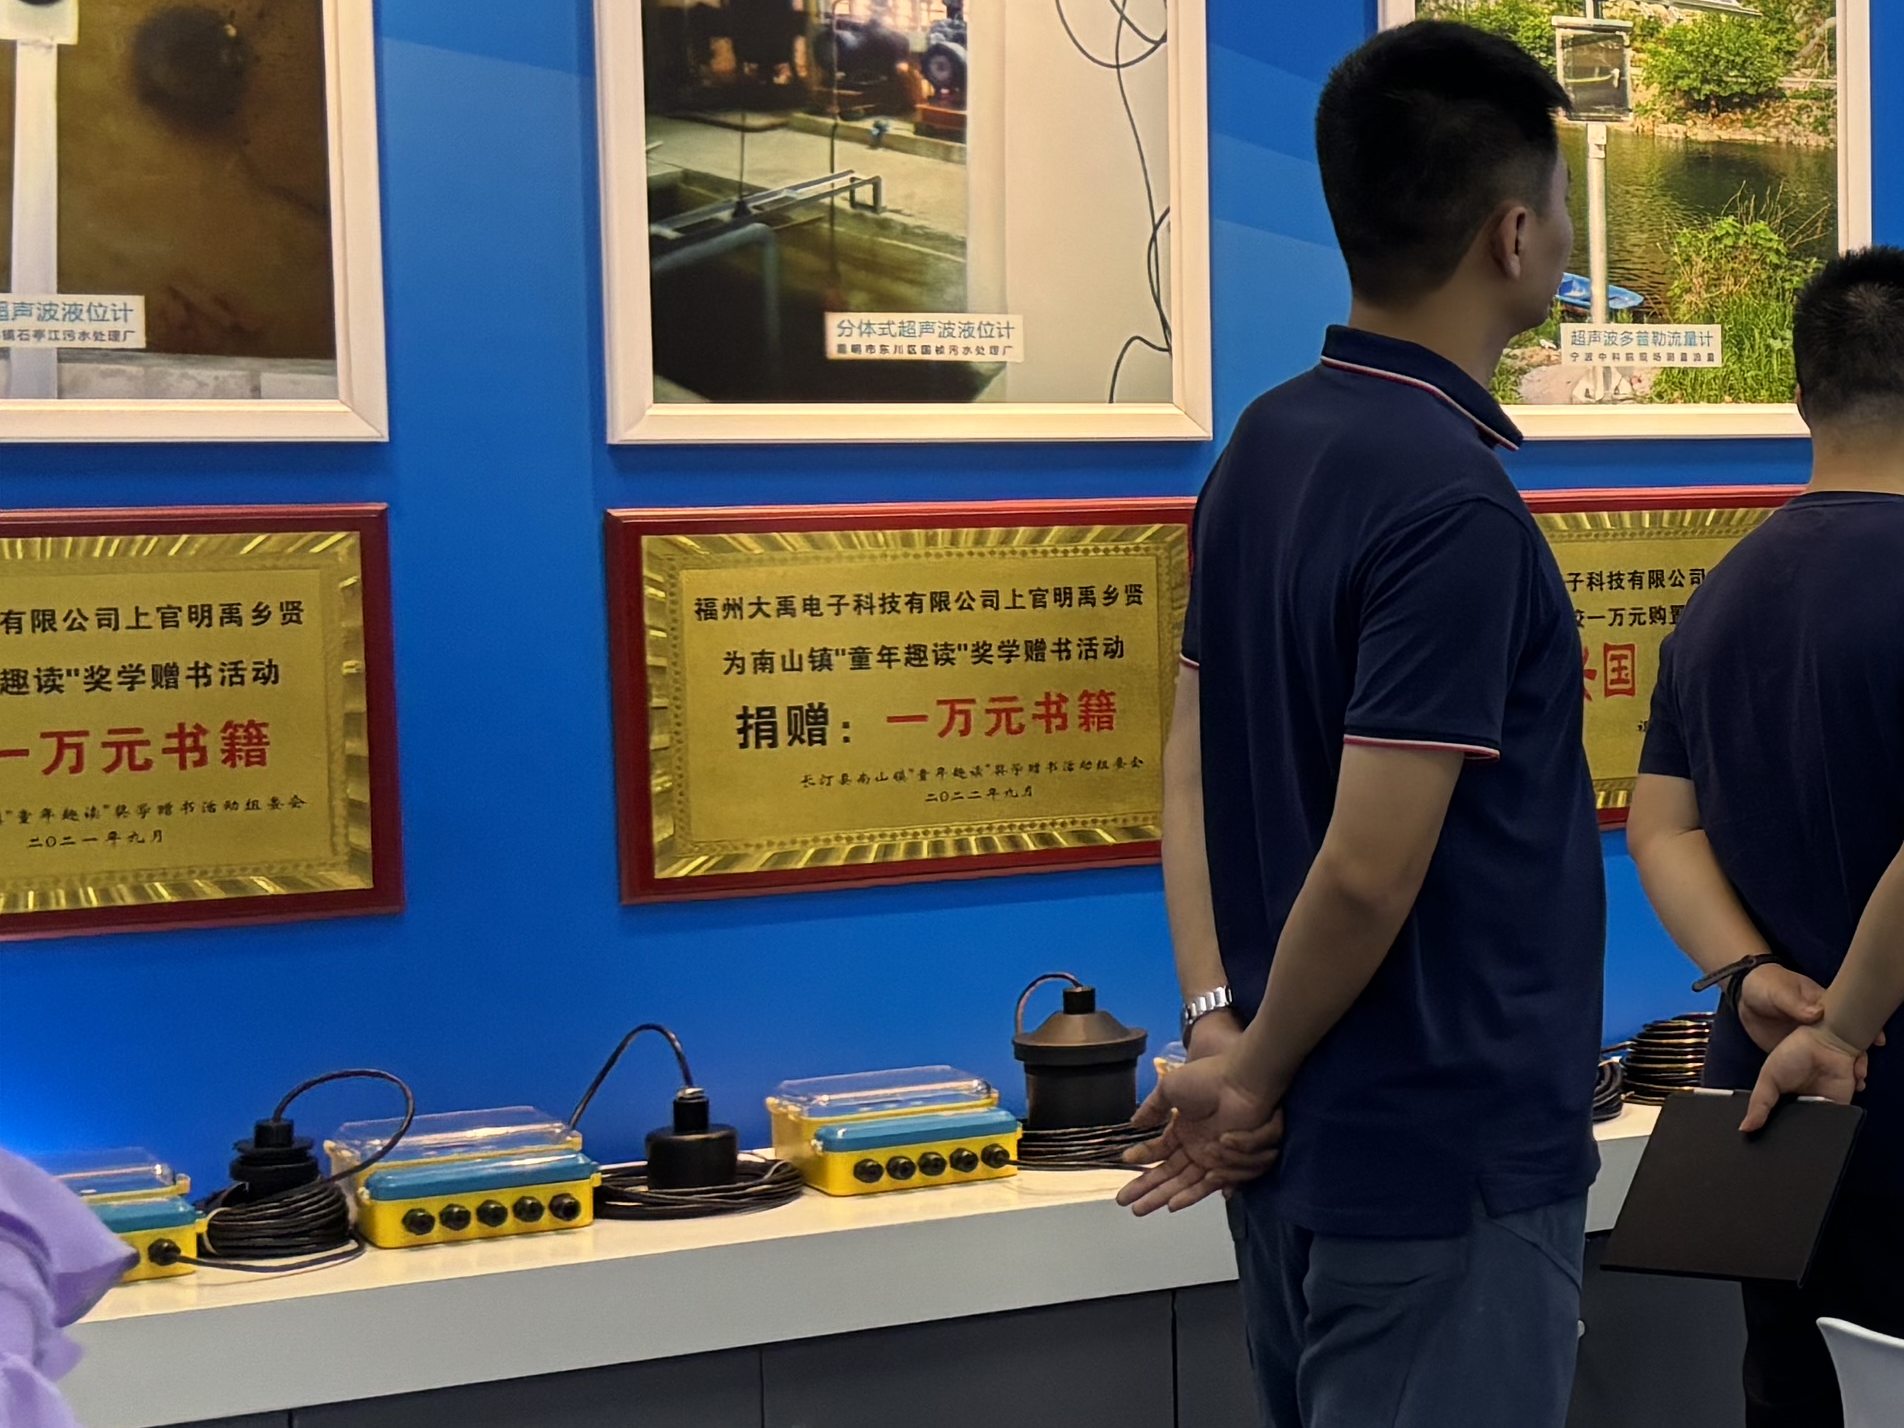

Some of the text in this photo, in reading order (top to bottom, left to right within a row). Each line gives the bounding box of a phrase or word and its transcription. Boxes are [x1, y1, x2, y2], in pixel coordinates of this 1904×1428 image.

[836, 318, 1015, 340] 分体式超声波液位计
[1570, 330, 1714, 348] 超声波多普勒流量计
[0, 600, 304, 635] 有限公司上官明禹乡贤
[694, 583, 1144, 622] 福州大禹电子科技有限公司上官明禹乡贤
[886, 689, 1118, 739] 一万元书籍
